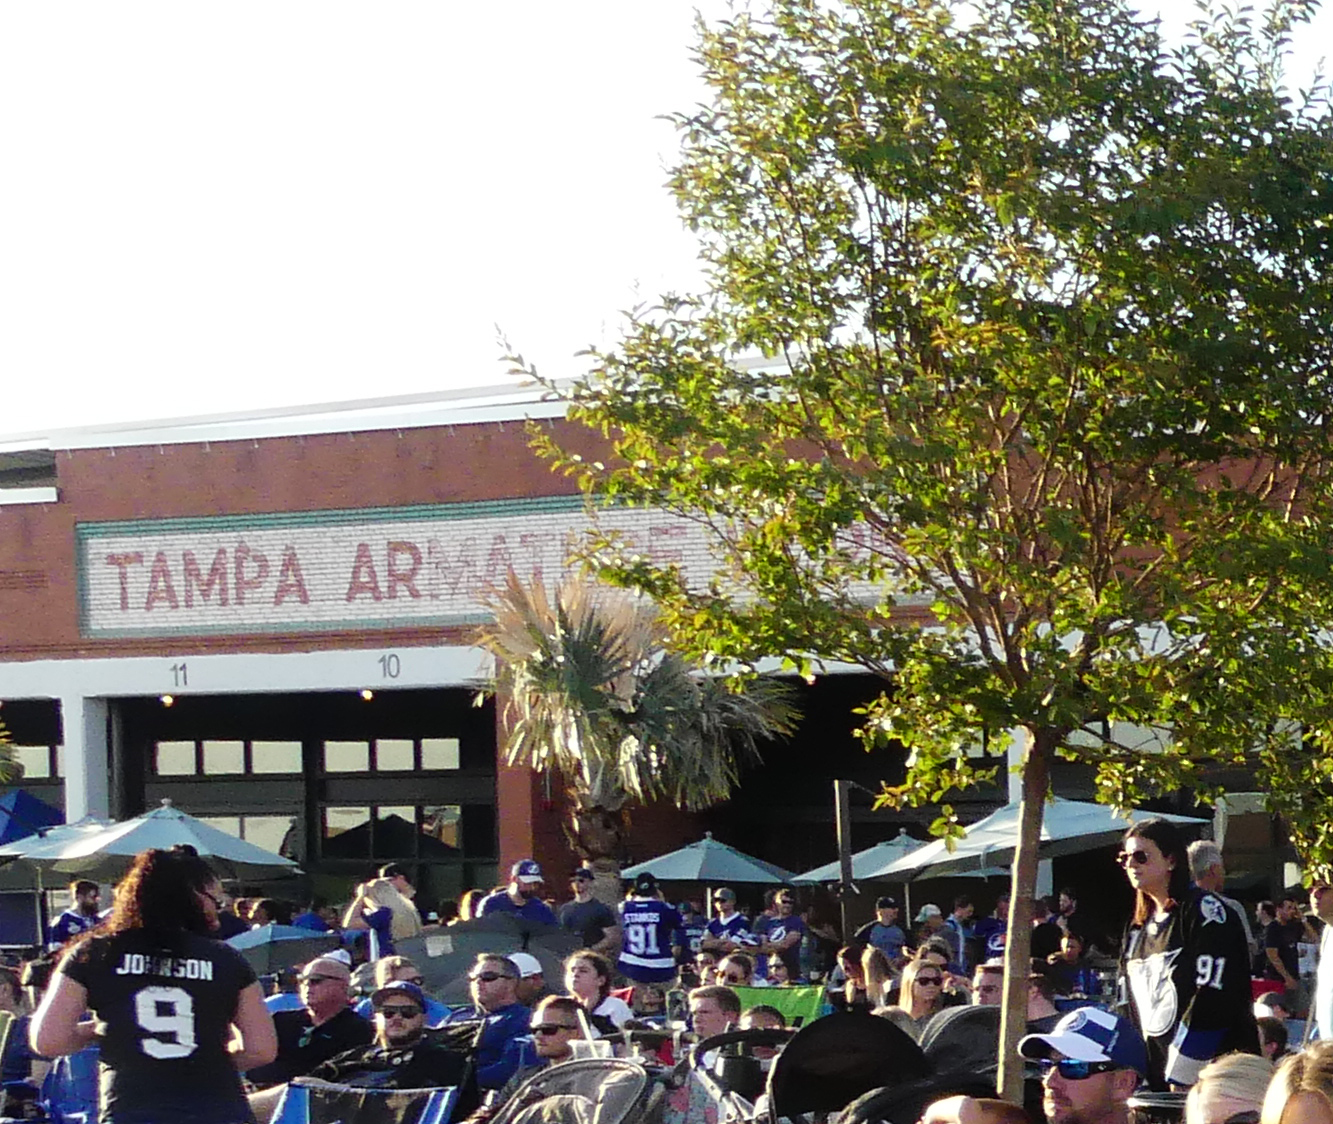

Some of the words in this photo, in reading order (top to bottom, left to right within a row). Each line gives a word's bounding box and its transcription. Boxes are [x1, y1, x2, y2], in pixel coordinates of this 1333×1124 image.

[106, 541, 311, 612] TAMPA
[169, 663, 188, 687] 11
[377, 653, 401, 679] 10
[628, 924, 660, 955] 91
[1196, 954, 1226, 990] 91
[135, 985, 198, 1060] 9
